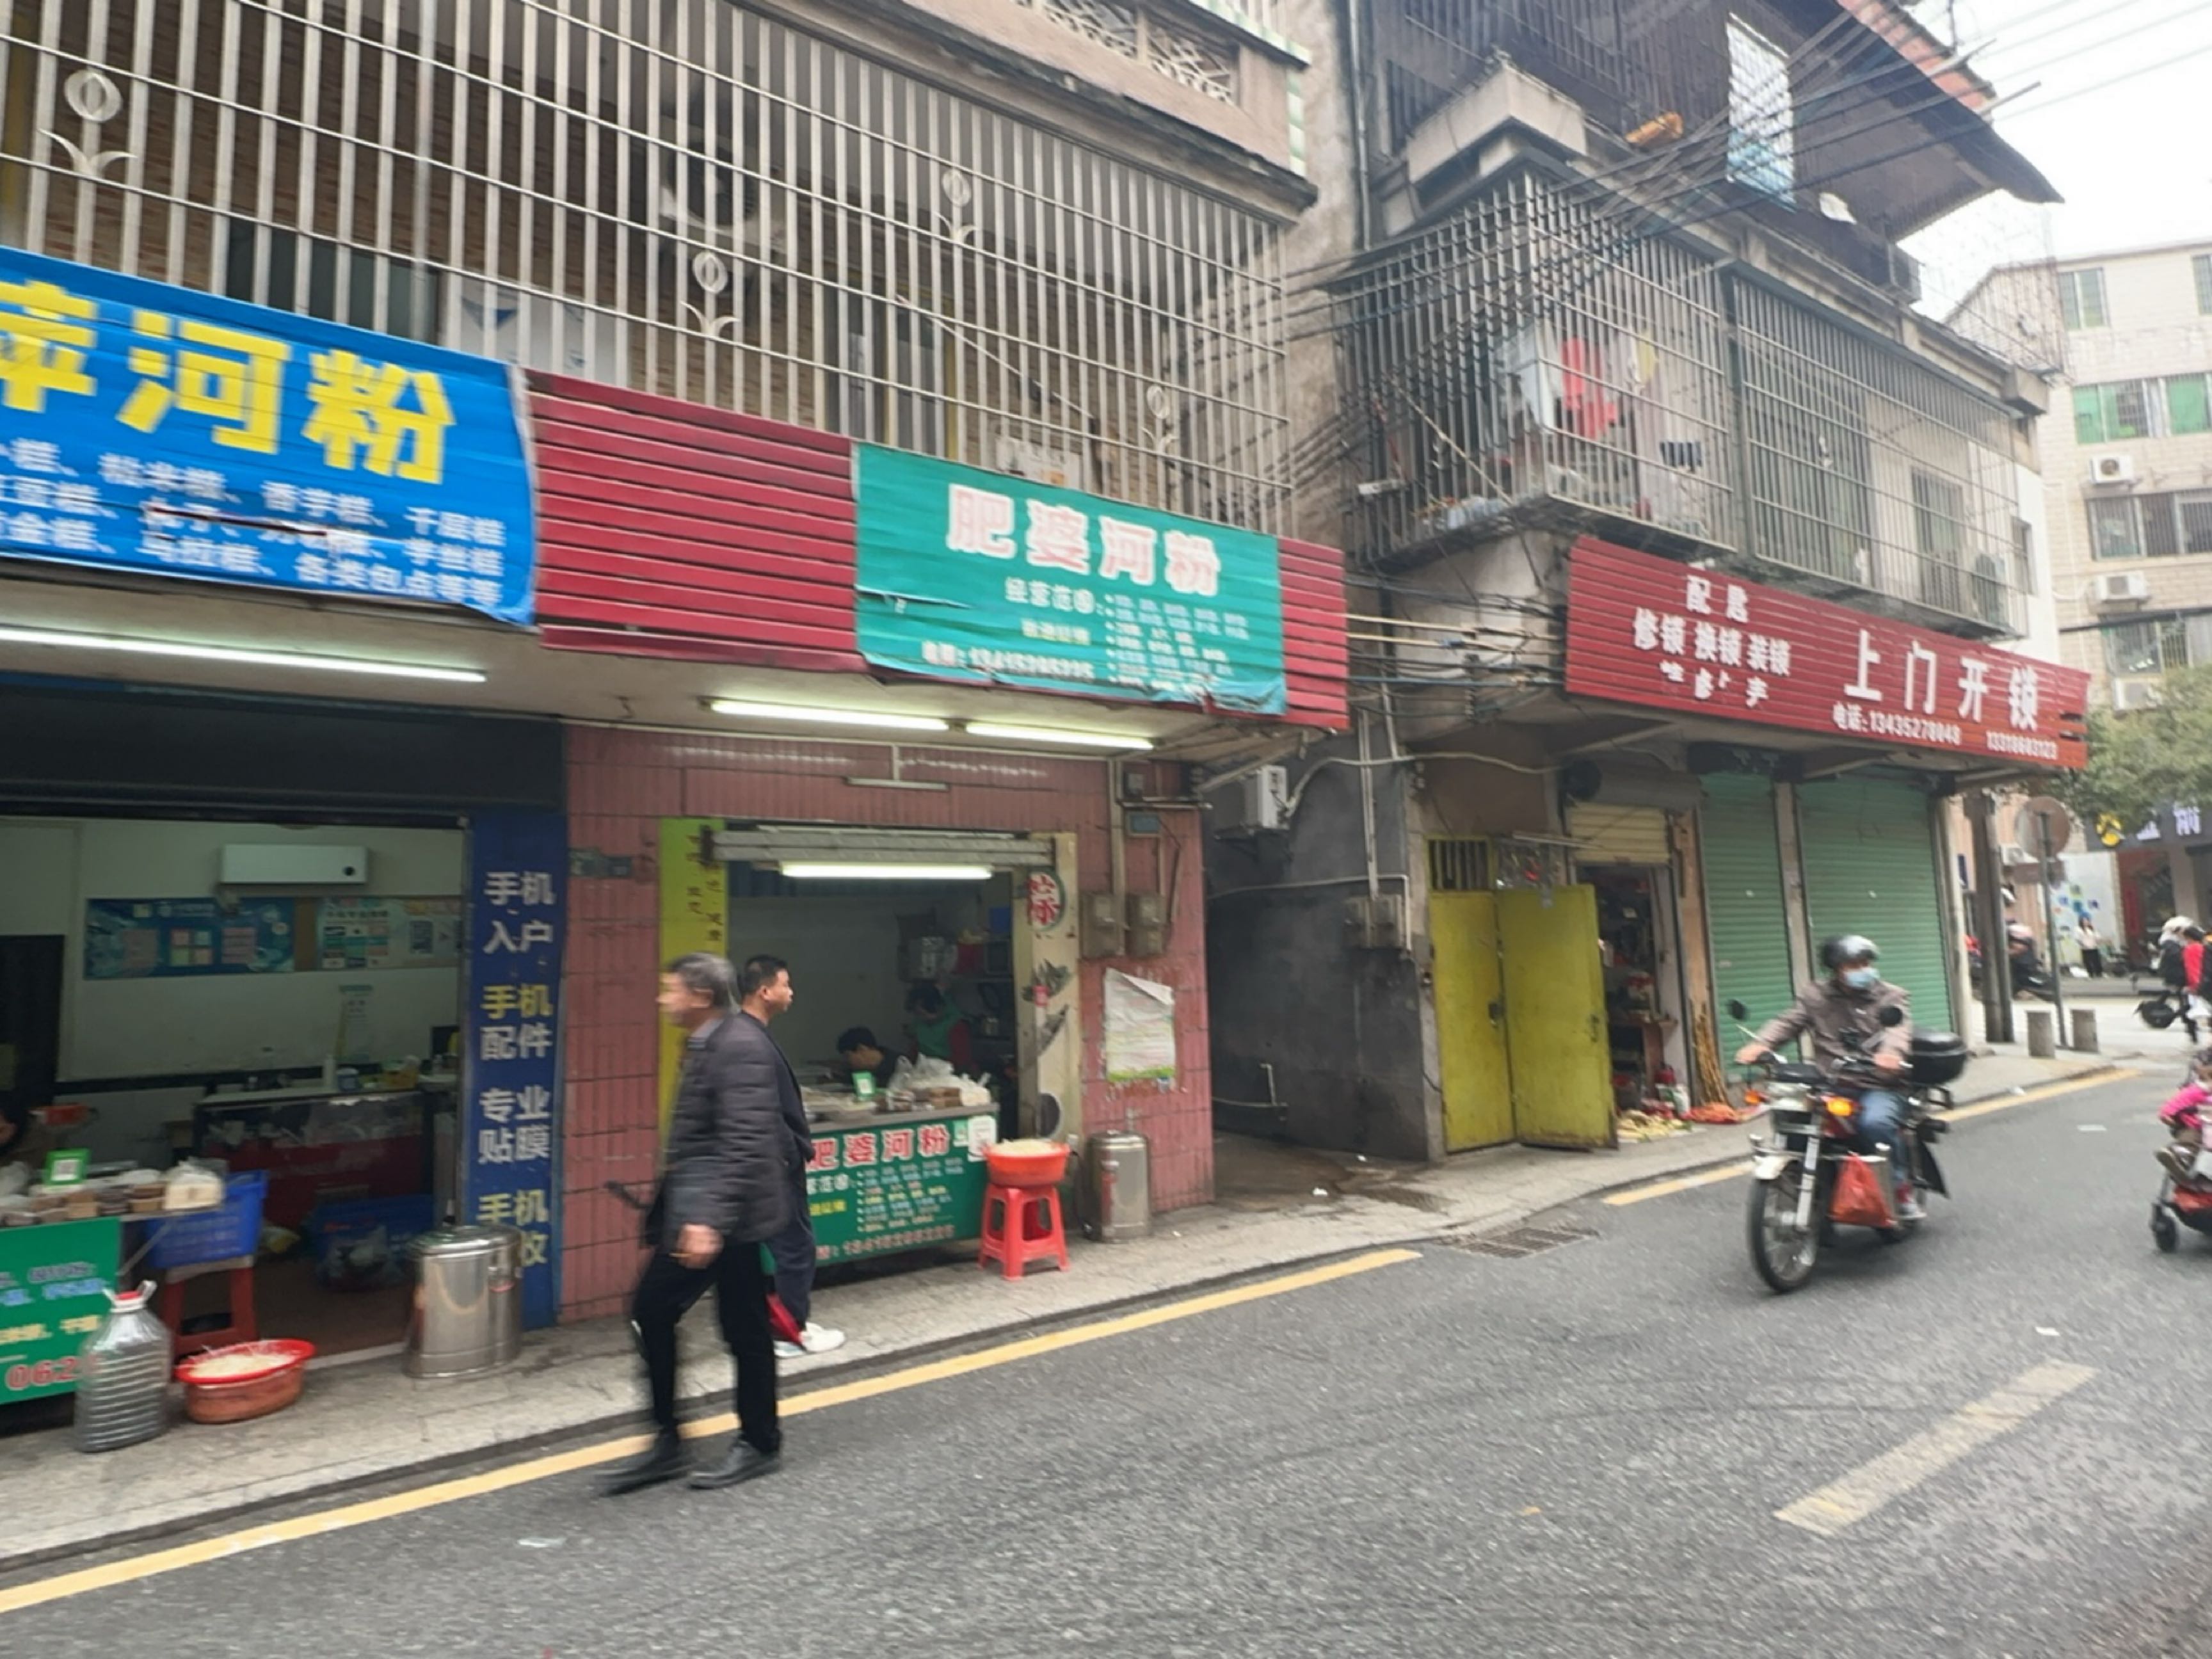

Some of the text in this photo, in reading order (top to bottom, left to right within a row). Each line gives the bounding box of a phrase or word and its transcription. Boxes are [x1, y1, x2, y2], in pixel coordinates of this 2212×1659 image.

[945, 483, 1221, 597] 肥婆河粉
[1843, 629, 2039, 732] 上门开锁
[484, 871, 556, 906] 手机
[483, 919, 554, 954] 入户
[481, 984, 552, 1019] 手机
[480, 1022, 552, 1061] 配件
[479, 1085, 551, 1123] 专业
[478, 1124, 550, 1164] 贴膜
[476, 1189, 549, 1224] 手机
